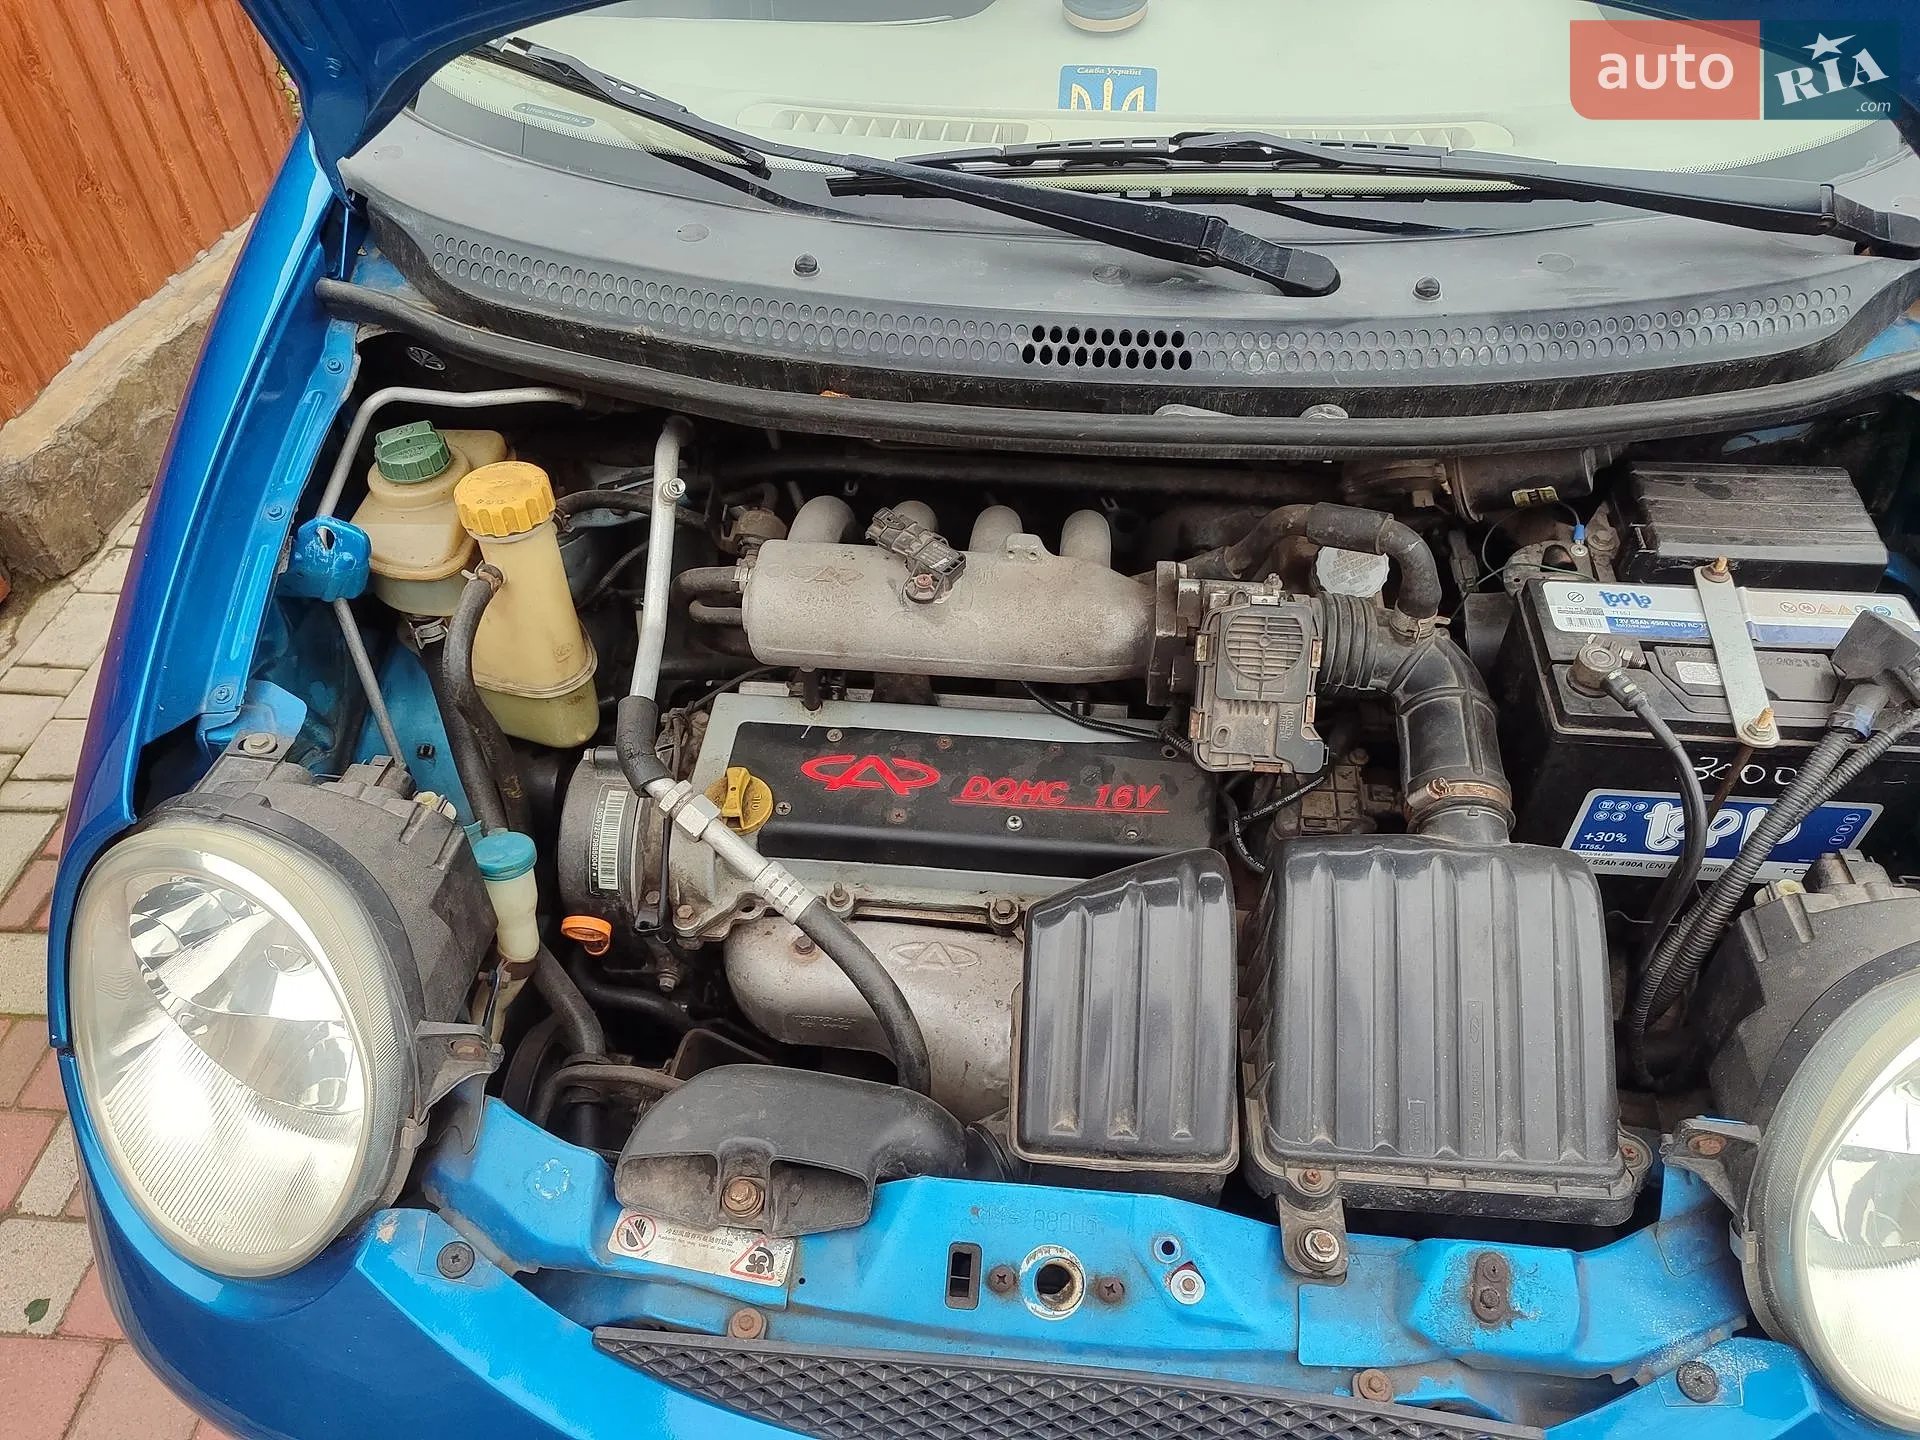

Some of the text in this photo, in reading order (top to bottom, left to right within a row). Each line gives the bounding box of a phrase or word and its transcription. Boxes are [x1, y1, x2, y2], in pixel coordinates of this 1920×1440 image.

[961, 775, 1162, 810] DOHC 16V
[752, 794, 763, 811] OIL
[1584, 831, 1627, 843] +30%
[1618, 860, 1643, 868] 490A
[1645, 862, 1666, 870] (EN)
[1703, 865, 1722, 873] min
